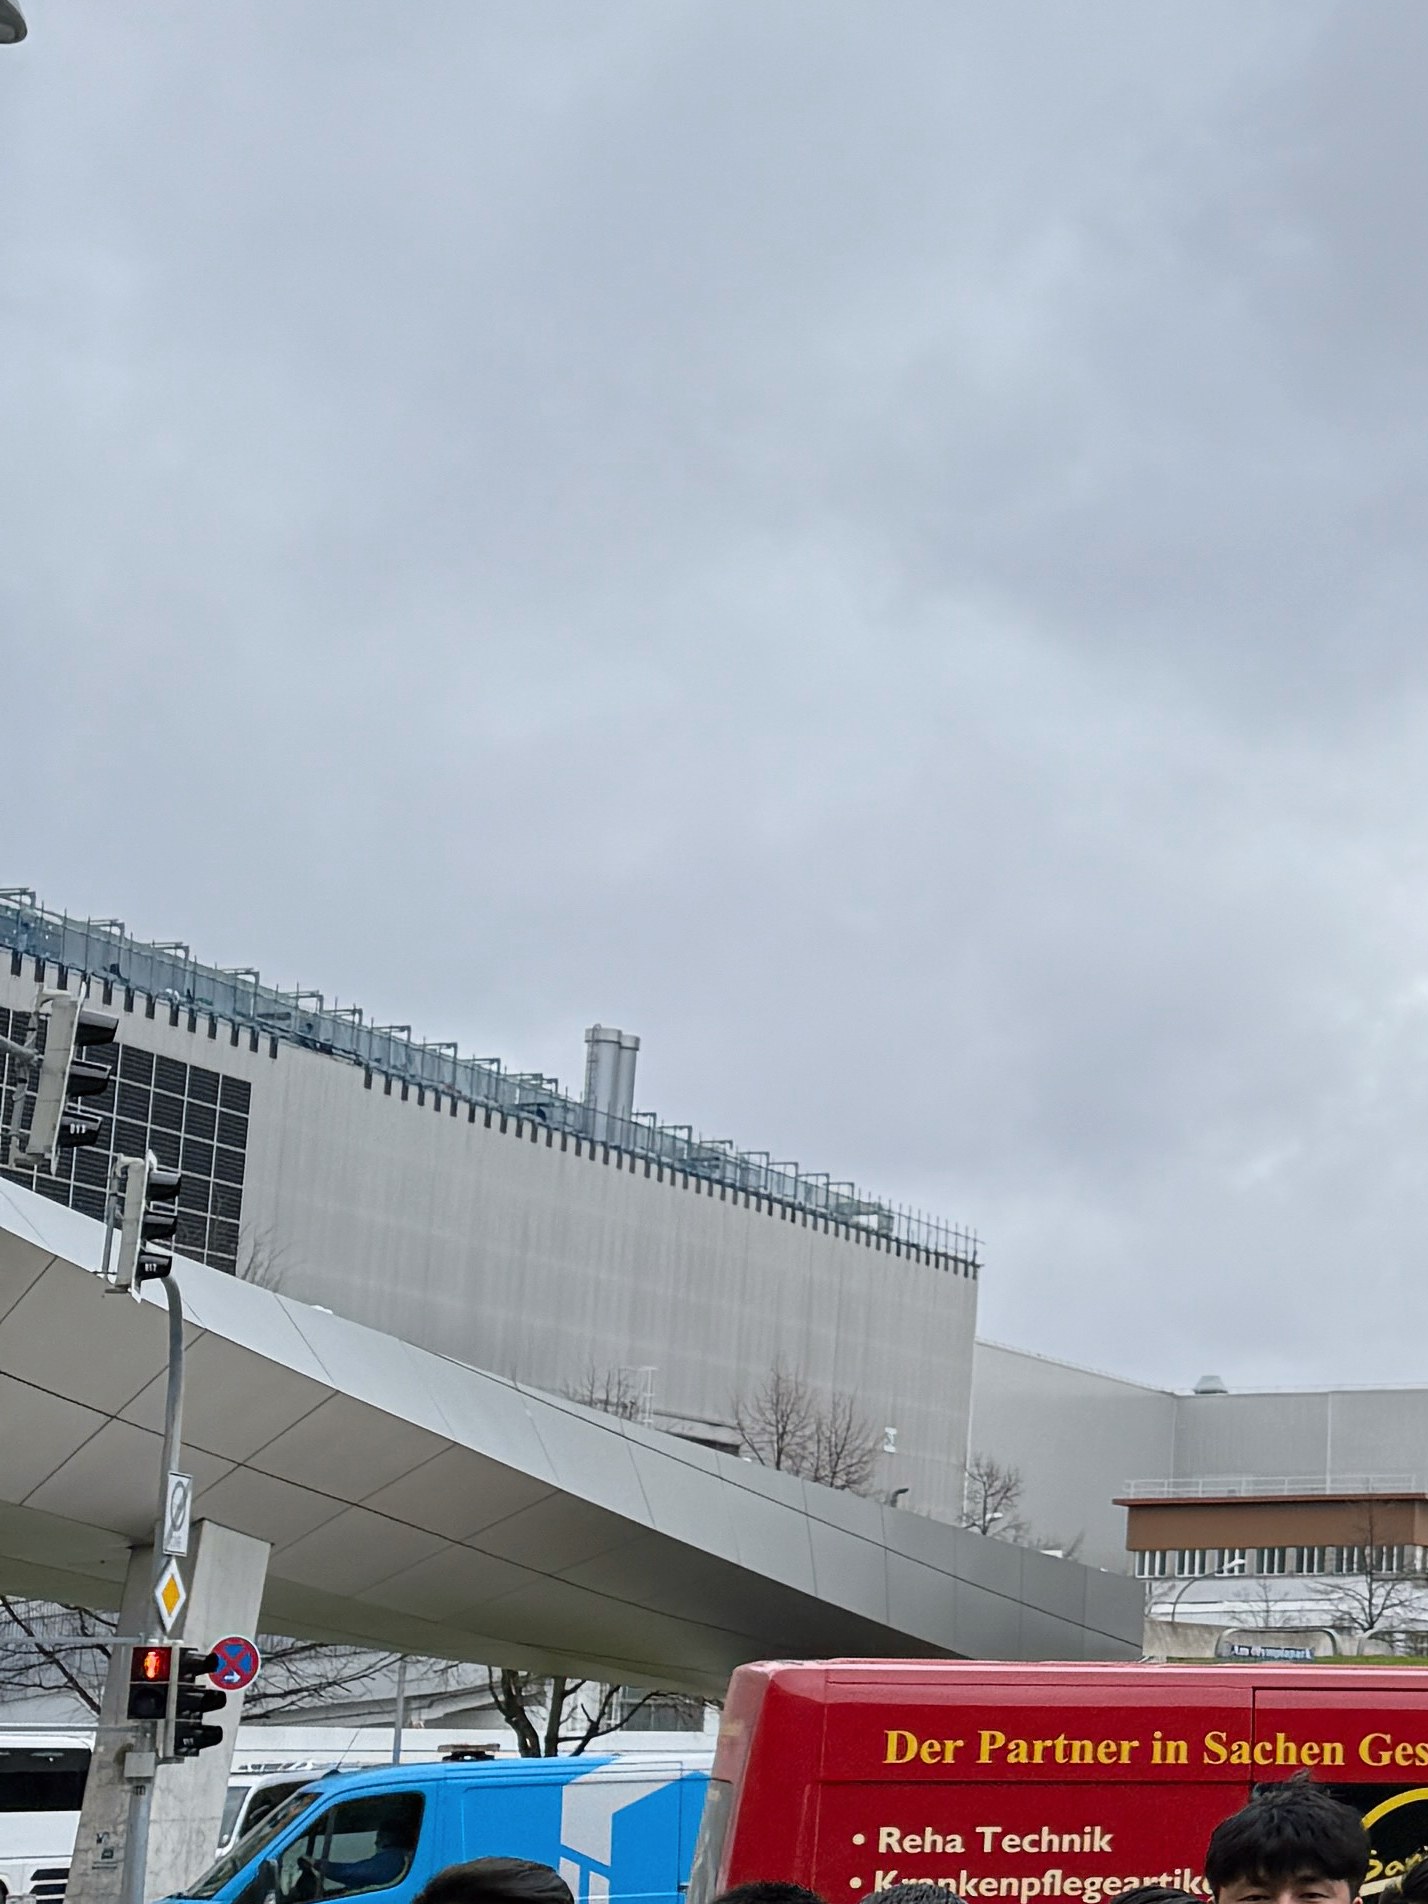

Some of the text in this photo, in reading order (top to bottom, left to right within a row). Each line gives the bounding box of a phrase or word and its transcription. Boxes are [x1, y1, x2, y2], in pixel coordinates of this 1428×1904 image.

[882, 1729, 965, 1765] Der
[975, 1729, 1140, 1765] Partner
[1150, 1730, 1189, 1764] in
[1202, 1730, 1346, 1766] Sachen
[877, 1825, 1115, 1854] Reha Technik
